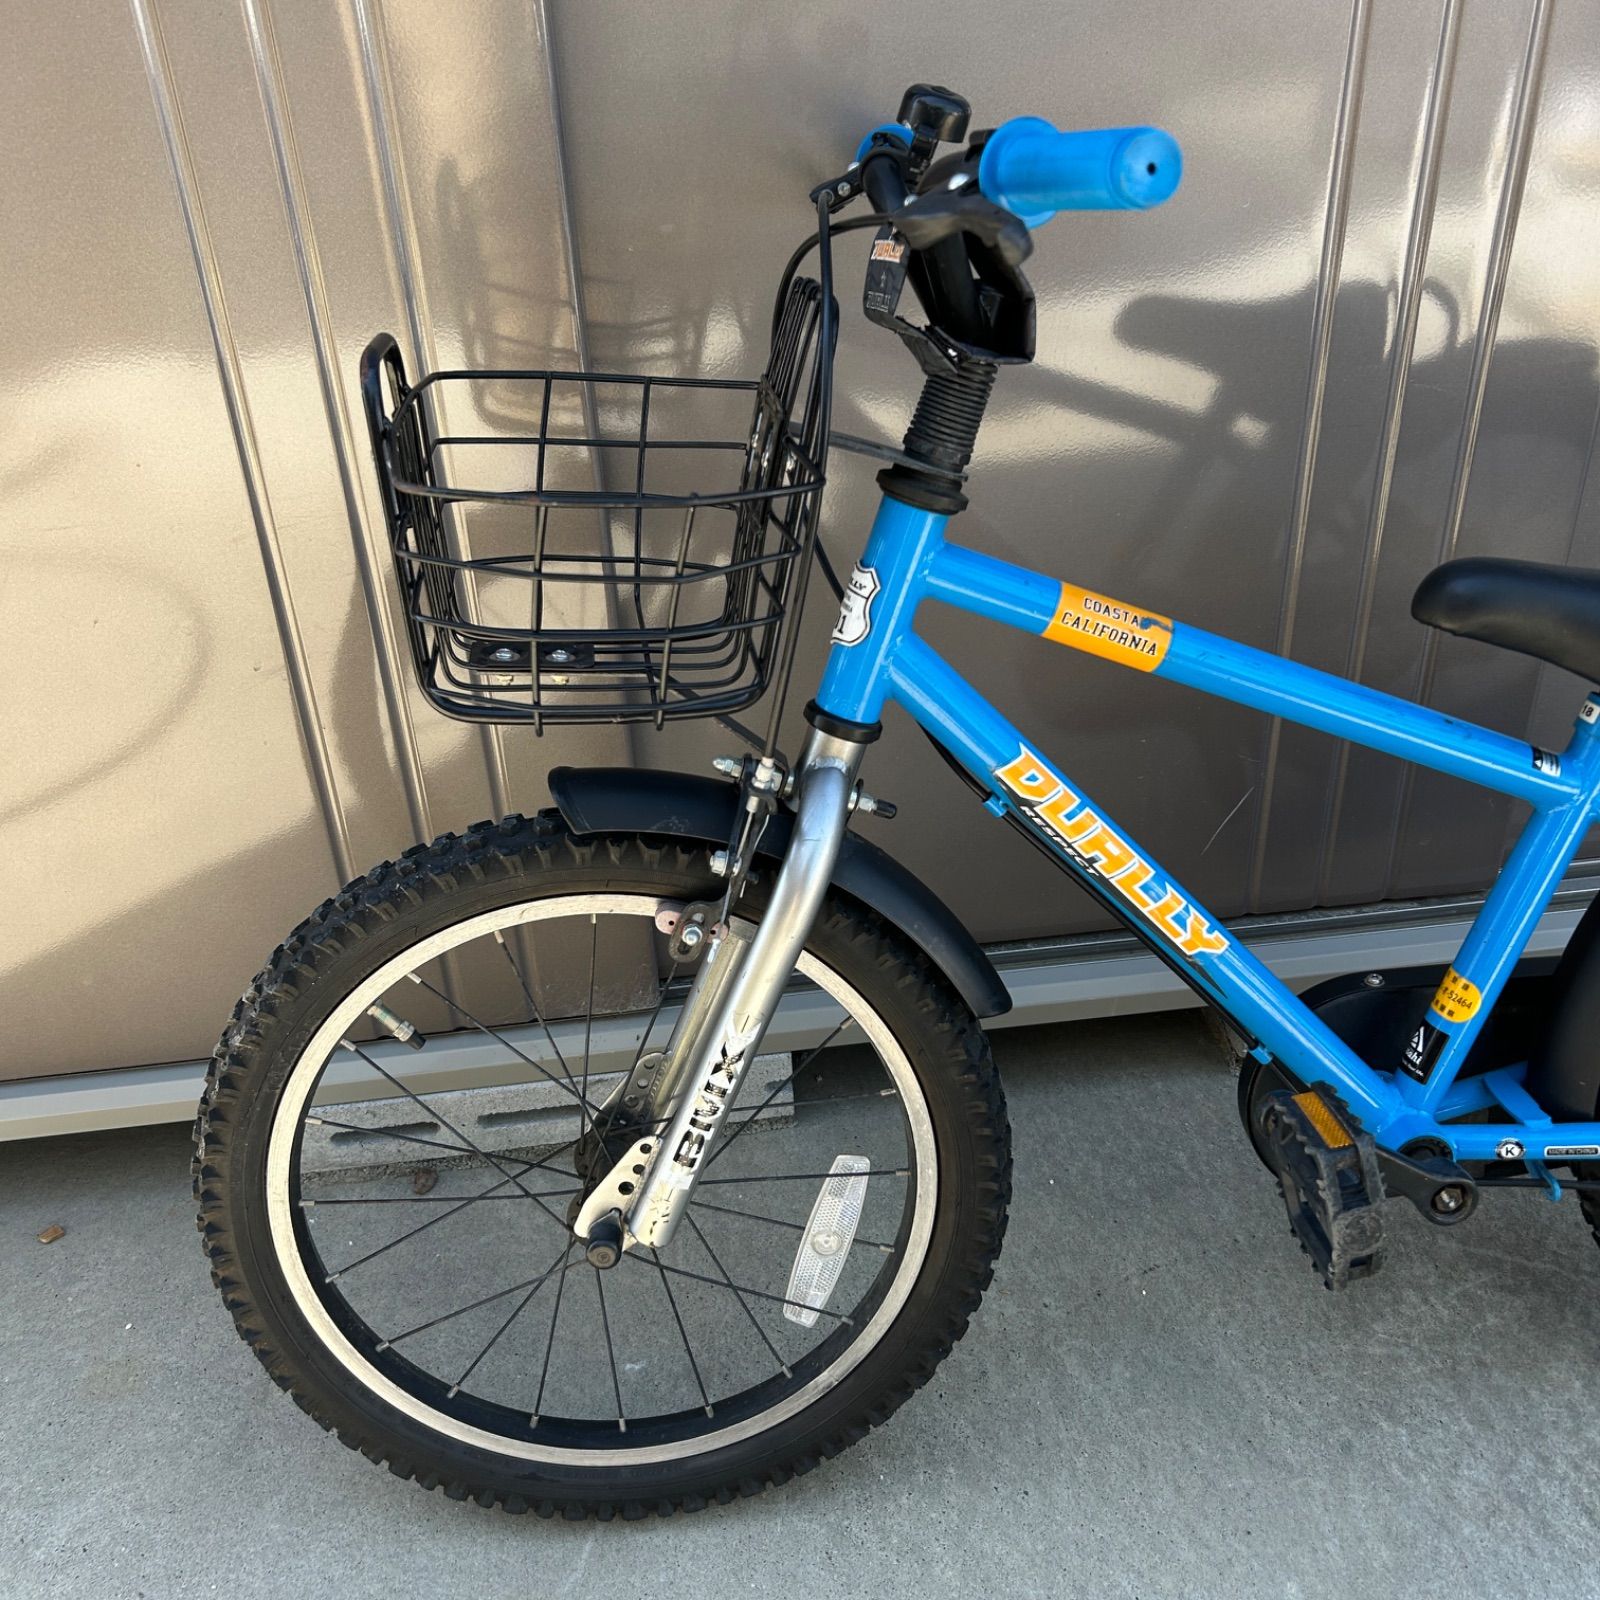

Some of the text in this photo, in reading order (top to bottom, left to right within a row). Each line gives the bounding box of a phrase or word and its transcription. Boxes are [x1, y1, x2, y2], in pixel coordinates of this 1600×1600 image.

[1061, 611, 1157, 656] CALIFORNIA
[1582, 704, 1595, 718] 18
[993, 741, 1231, 955] DUALLY
[1020, 805, 1099, 876] RESPECT
[672, 1041, 746, 1168] BMX
